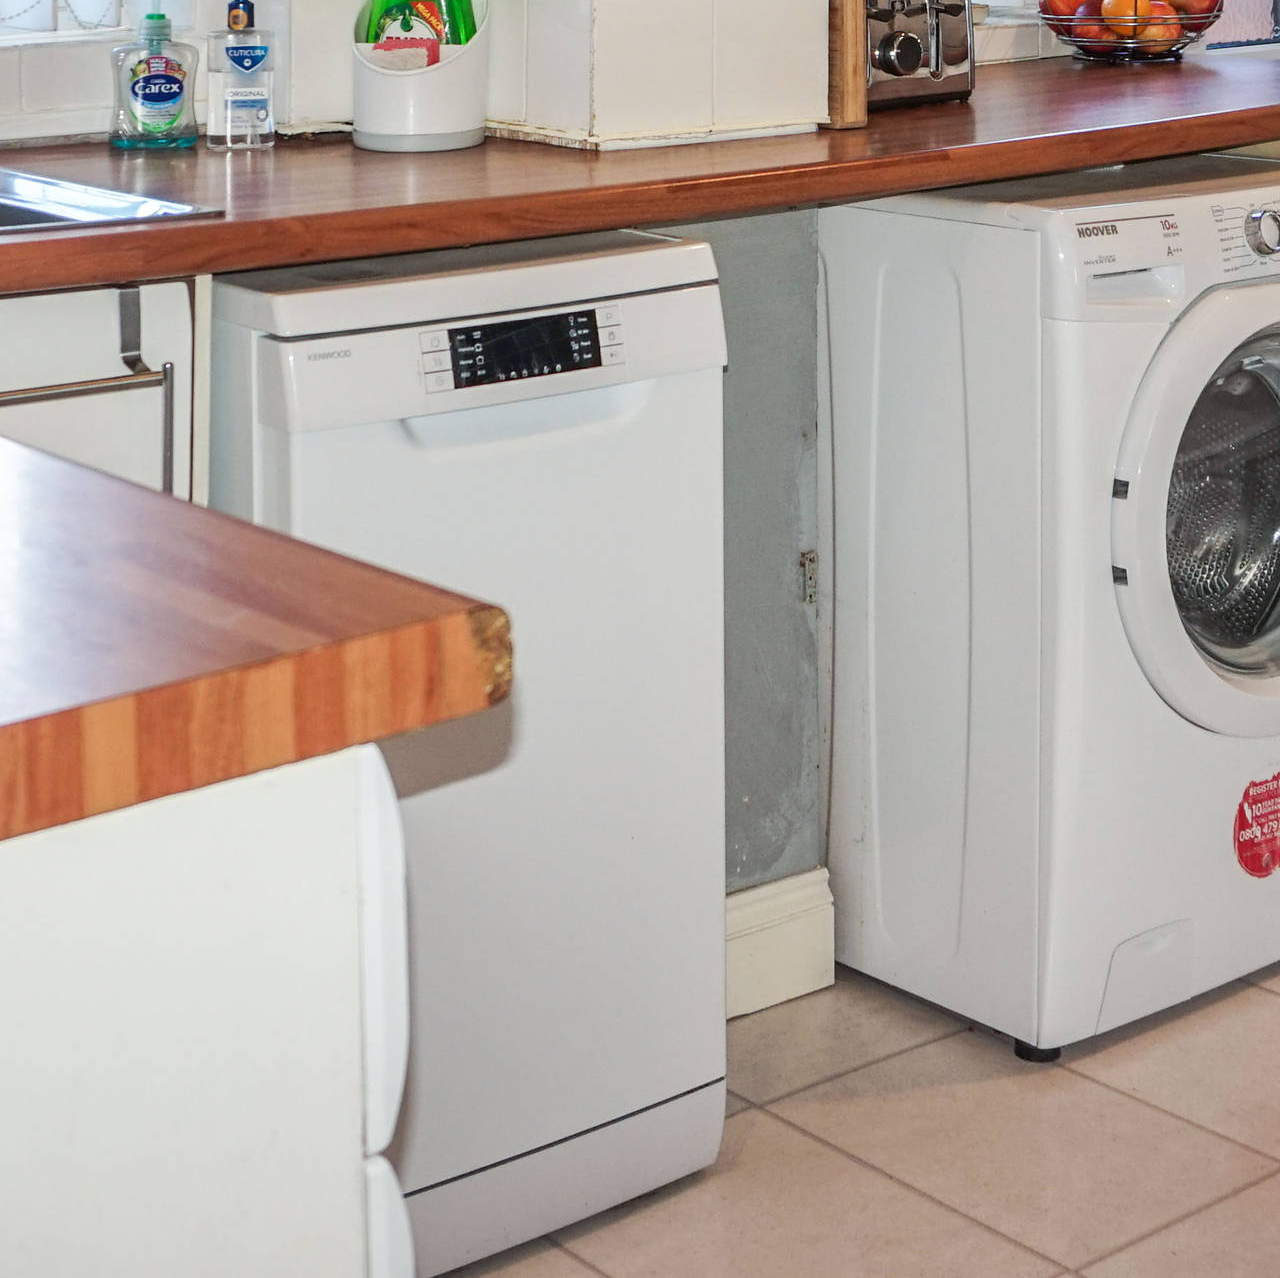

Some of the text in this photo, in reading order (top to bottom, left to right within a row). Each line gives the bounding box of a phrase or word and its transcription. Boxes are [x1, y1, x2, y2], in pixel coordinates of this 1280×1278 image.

[416, 3, 430, 17] MEGA
[135, 83, 180, 94] Carex
[1077, 224, 1118, 238] HOOVER
[1249, 781, 1278, 796] REGISTER
[1252, 803, 1262, 817] 10
[1263, 821, 1278, 834] 479
